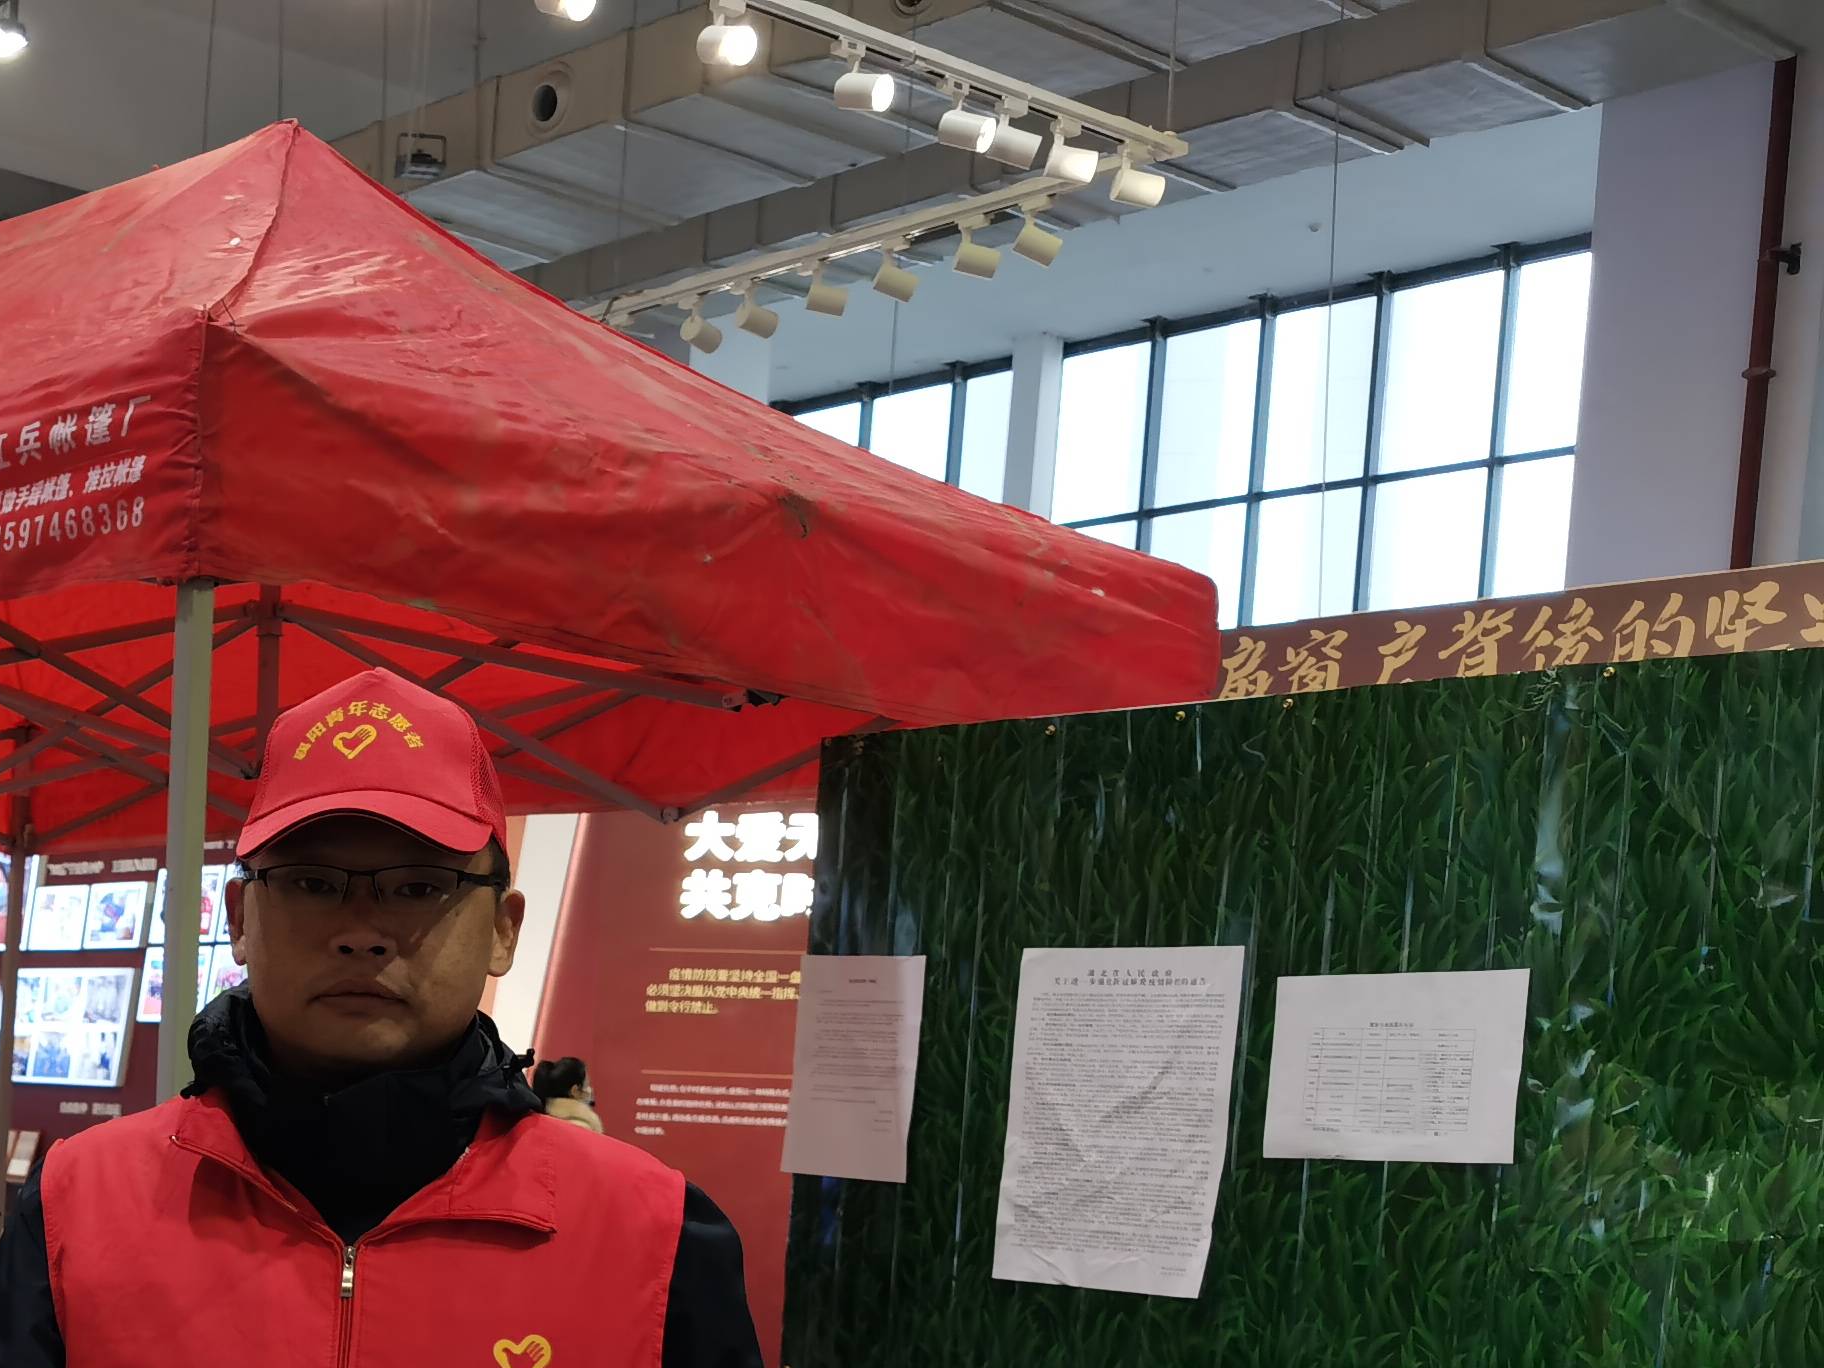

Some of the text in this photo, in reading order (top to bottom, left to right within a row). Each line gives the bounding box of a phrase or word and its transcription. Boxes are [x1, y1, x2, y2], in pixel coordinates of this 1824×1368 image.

[293, 700, 424, 761] 襄阳青年志愿者
